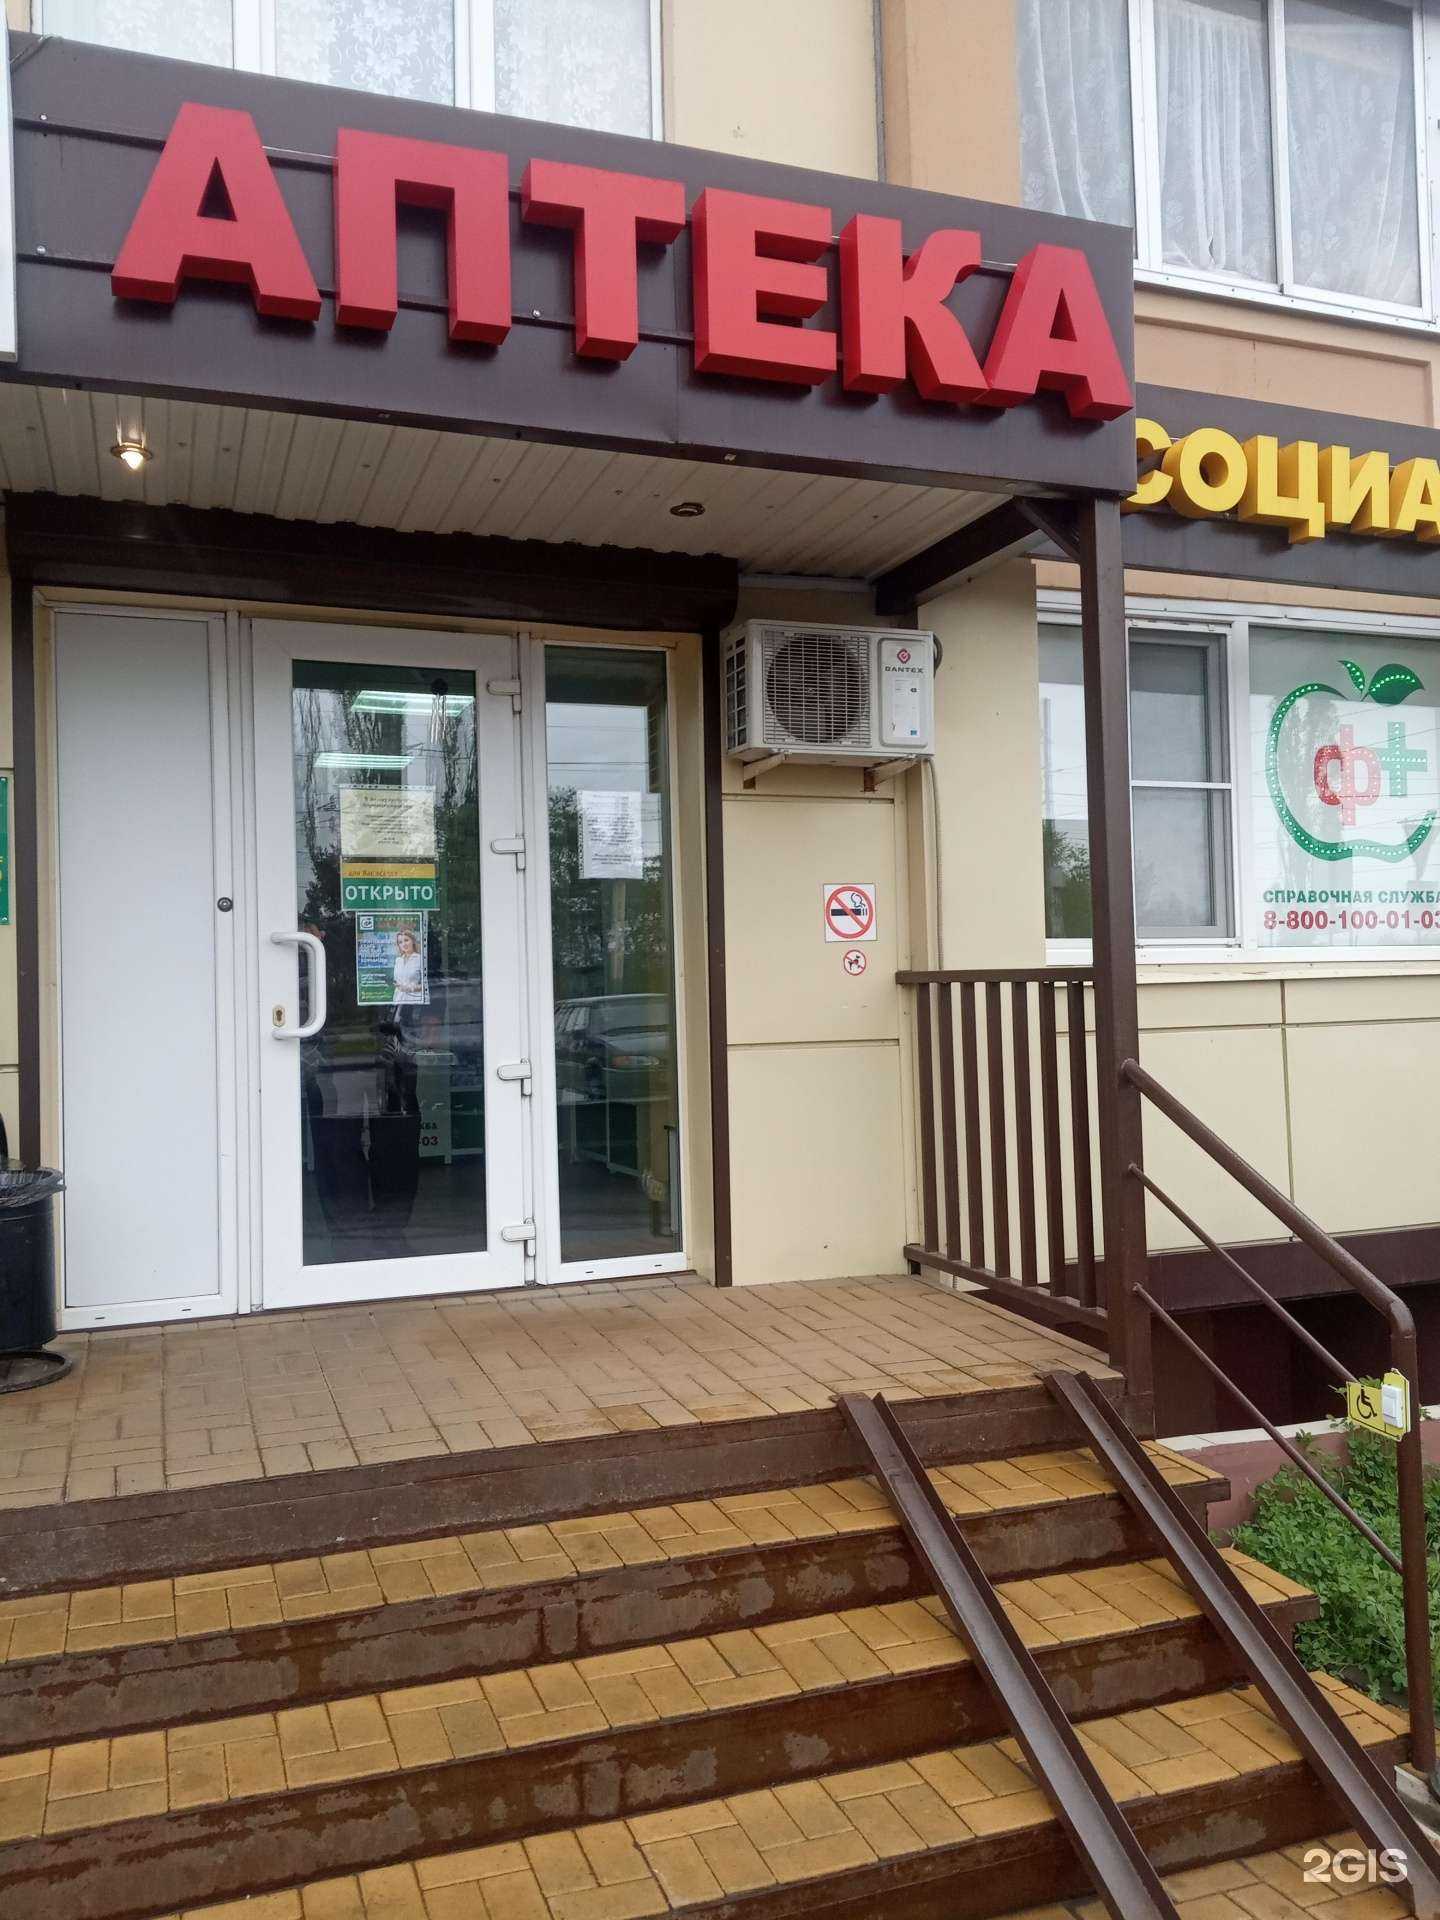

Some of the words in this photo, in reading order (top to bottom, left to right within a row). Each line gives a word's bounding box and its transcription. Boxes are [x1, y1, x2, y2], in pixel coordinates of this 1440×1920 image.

[111, 102, 1134, 421] АПТЕКА
[884, 665, 924, 674] DANTEX
[345, 885, 433, 900] ОТКРЫТО
[1263, 890, 1373, 904] СПРАВОЧНАЯ
